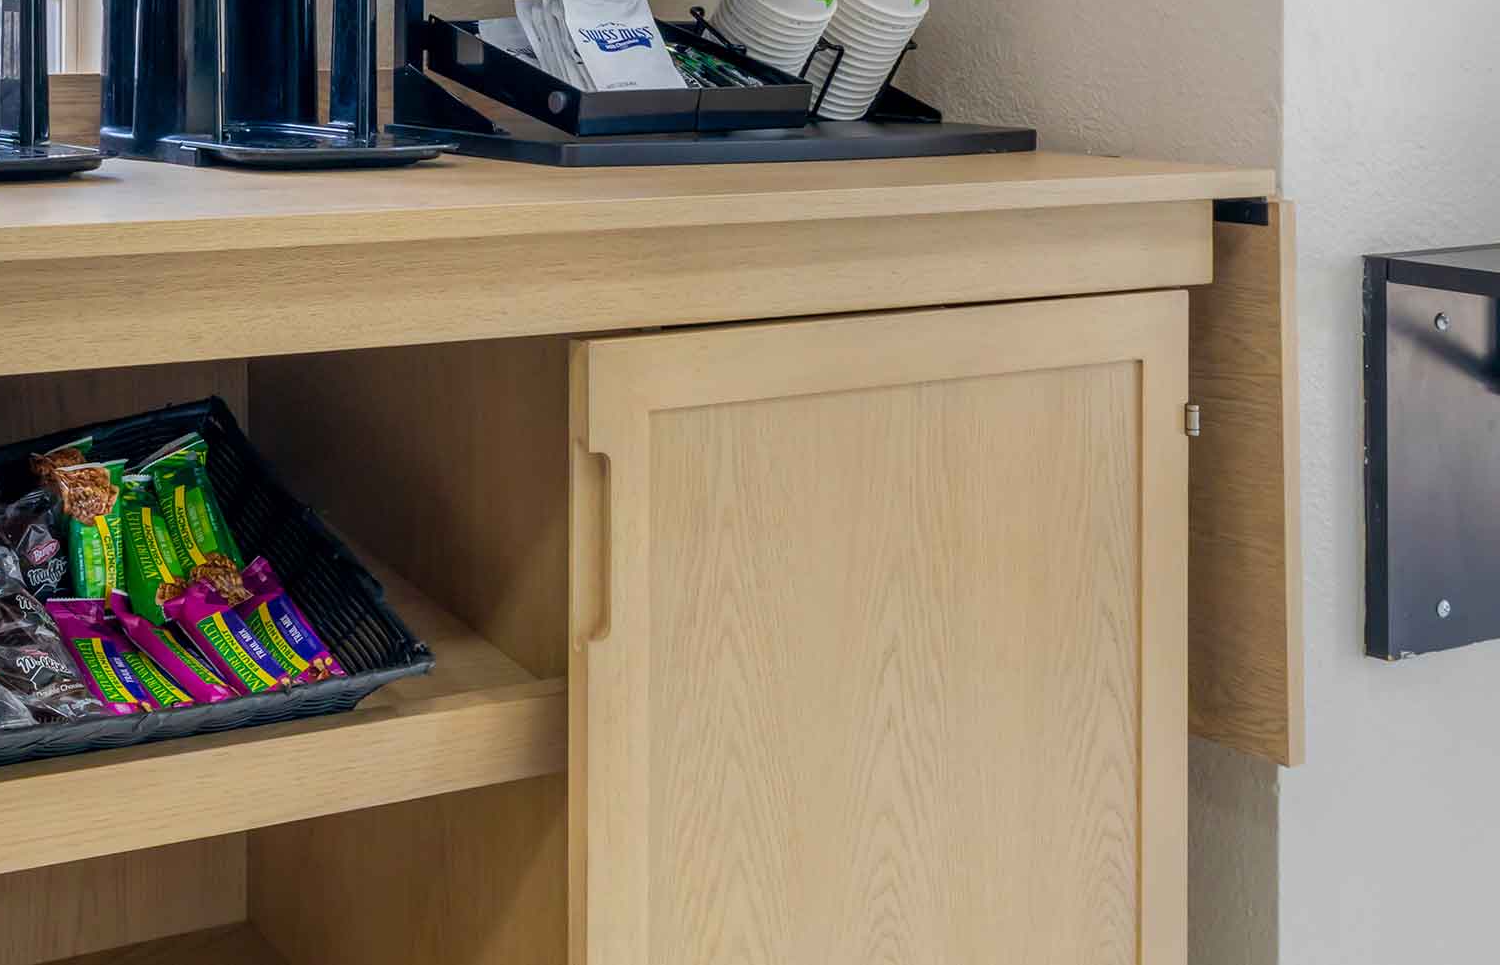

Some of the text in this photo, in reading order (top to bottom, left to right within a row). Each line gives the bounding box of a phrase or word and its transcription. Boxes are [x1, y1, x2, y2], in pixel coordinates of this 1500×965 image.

[145, 524, 163, 566] CRUNCHY
[177, 507, 194, 550] CRUNCHY
[103, 535, 116, 589] CRUNCHY
[238, 628, 267, 660] TRAIL MIX
[279, 614, 304, 644] TRAIL MIX
[202, 621, 263, 692] NATURE VALLEY
[238, 650, 259, 673] FRUIT
[276, 641, 294, 660] FRUIT
